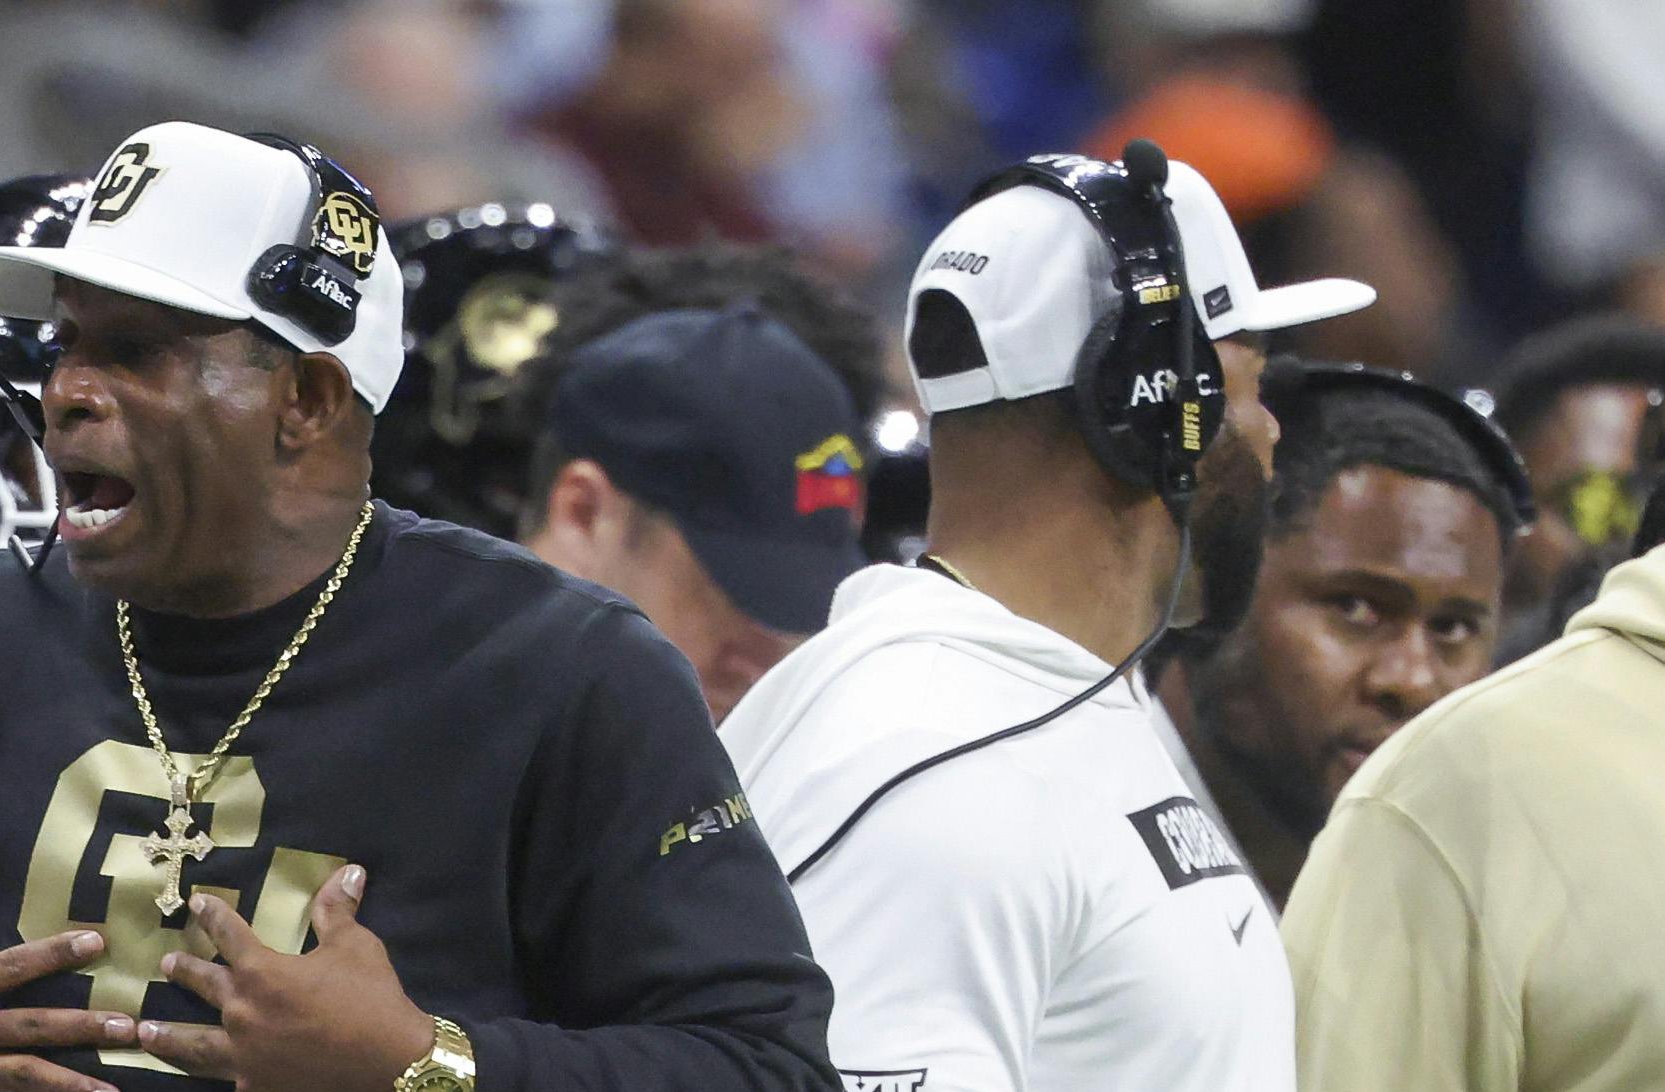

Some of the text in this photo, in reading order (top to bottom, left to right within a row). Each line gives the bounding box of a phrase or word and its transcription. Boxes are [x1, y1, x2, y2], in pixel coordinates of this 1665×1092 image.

[89, 142, 161, 222] CU
[326, 199, 373, 253] CU
[311, 275, 353, 311] Aflac
[1183, 402, 1200, 451] BUFFS
